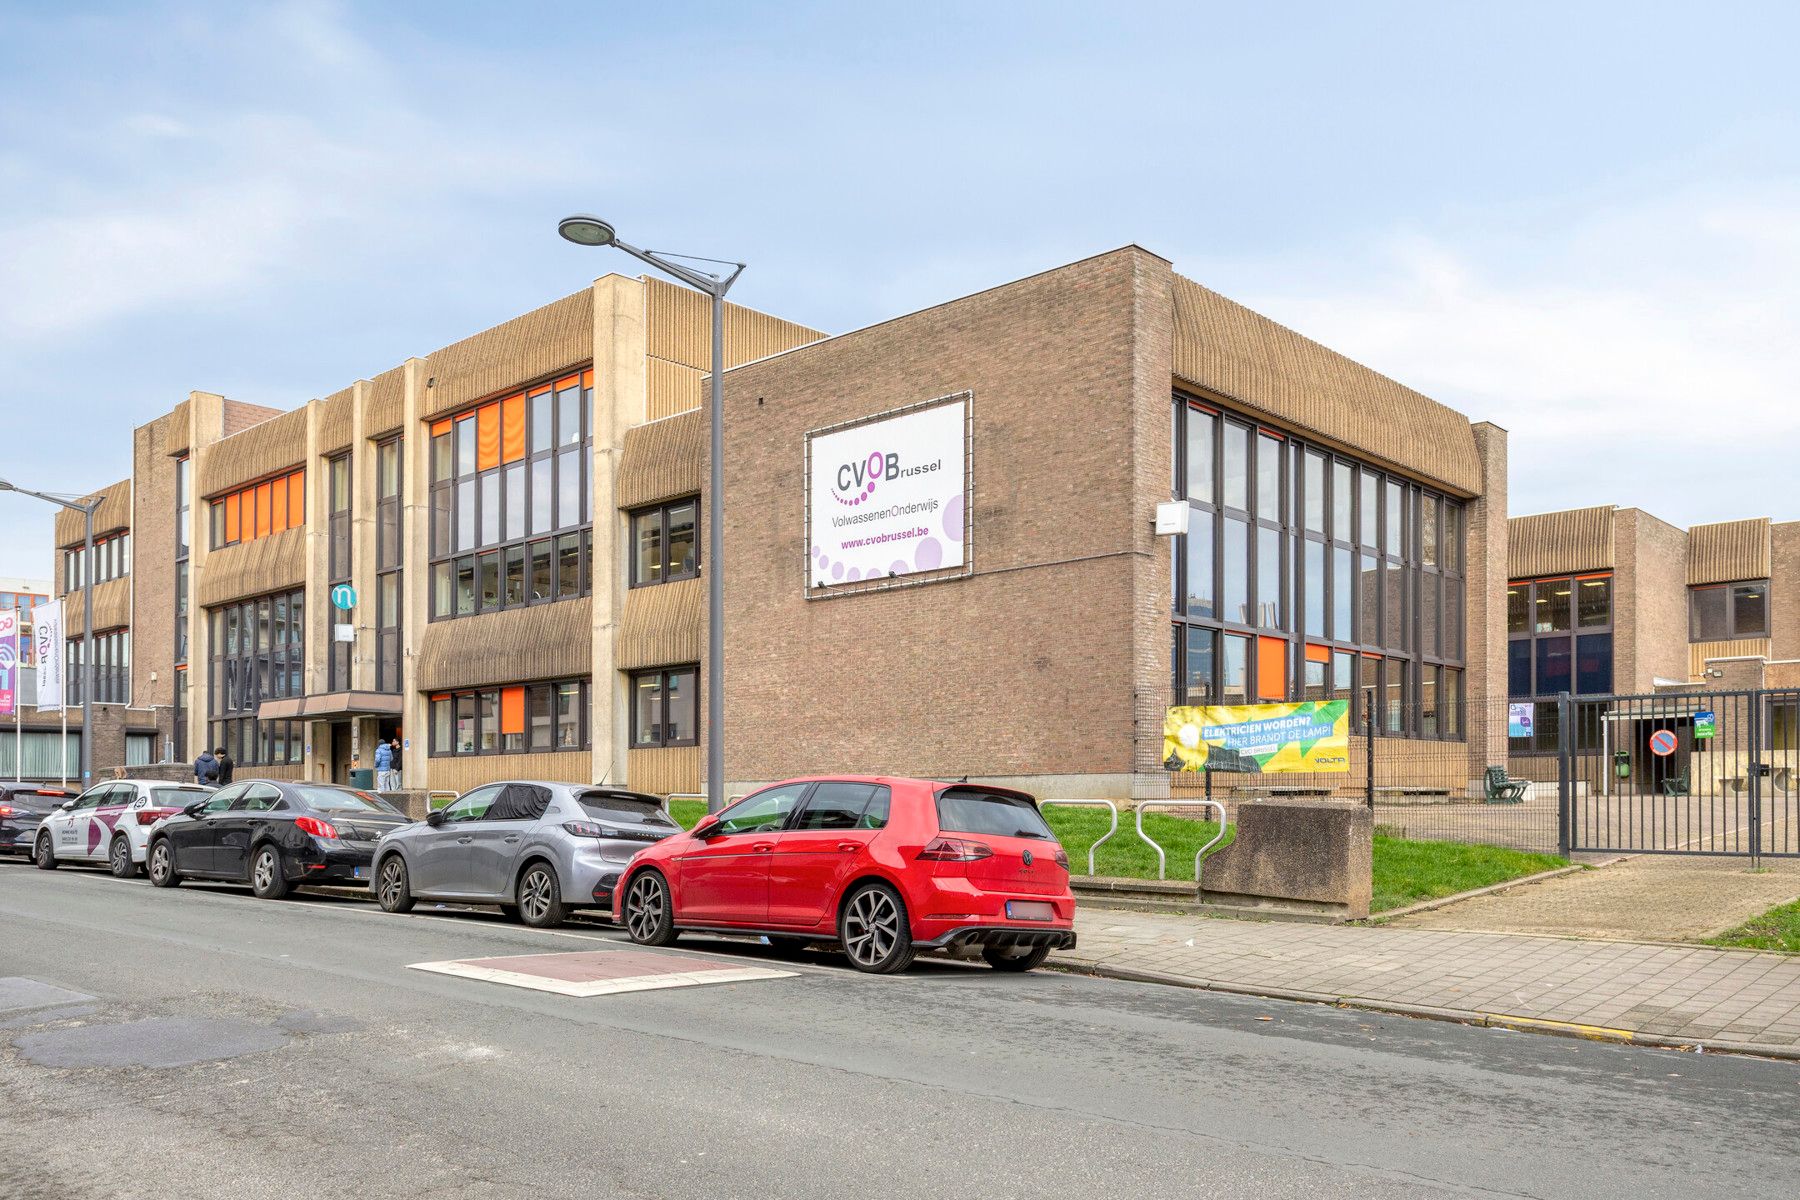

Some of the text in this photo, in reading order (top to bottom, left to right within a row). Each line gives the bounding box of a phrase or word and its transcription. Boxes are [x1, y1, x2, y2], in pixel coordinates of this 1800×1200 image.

[837, 451, 942, 491] CVOBrussel
[832, 498, 939, 528] VolwassenenOnderwijs
[841, 526, 929, 550] www.cvobrussel.be
[1204, 716, 1312, 738] ELEKTRICIEN WORDEN?
[1227, 725, 1331, 747] HIER BRANDT DE LAMP!
